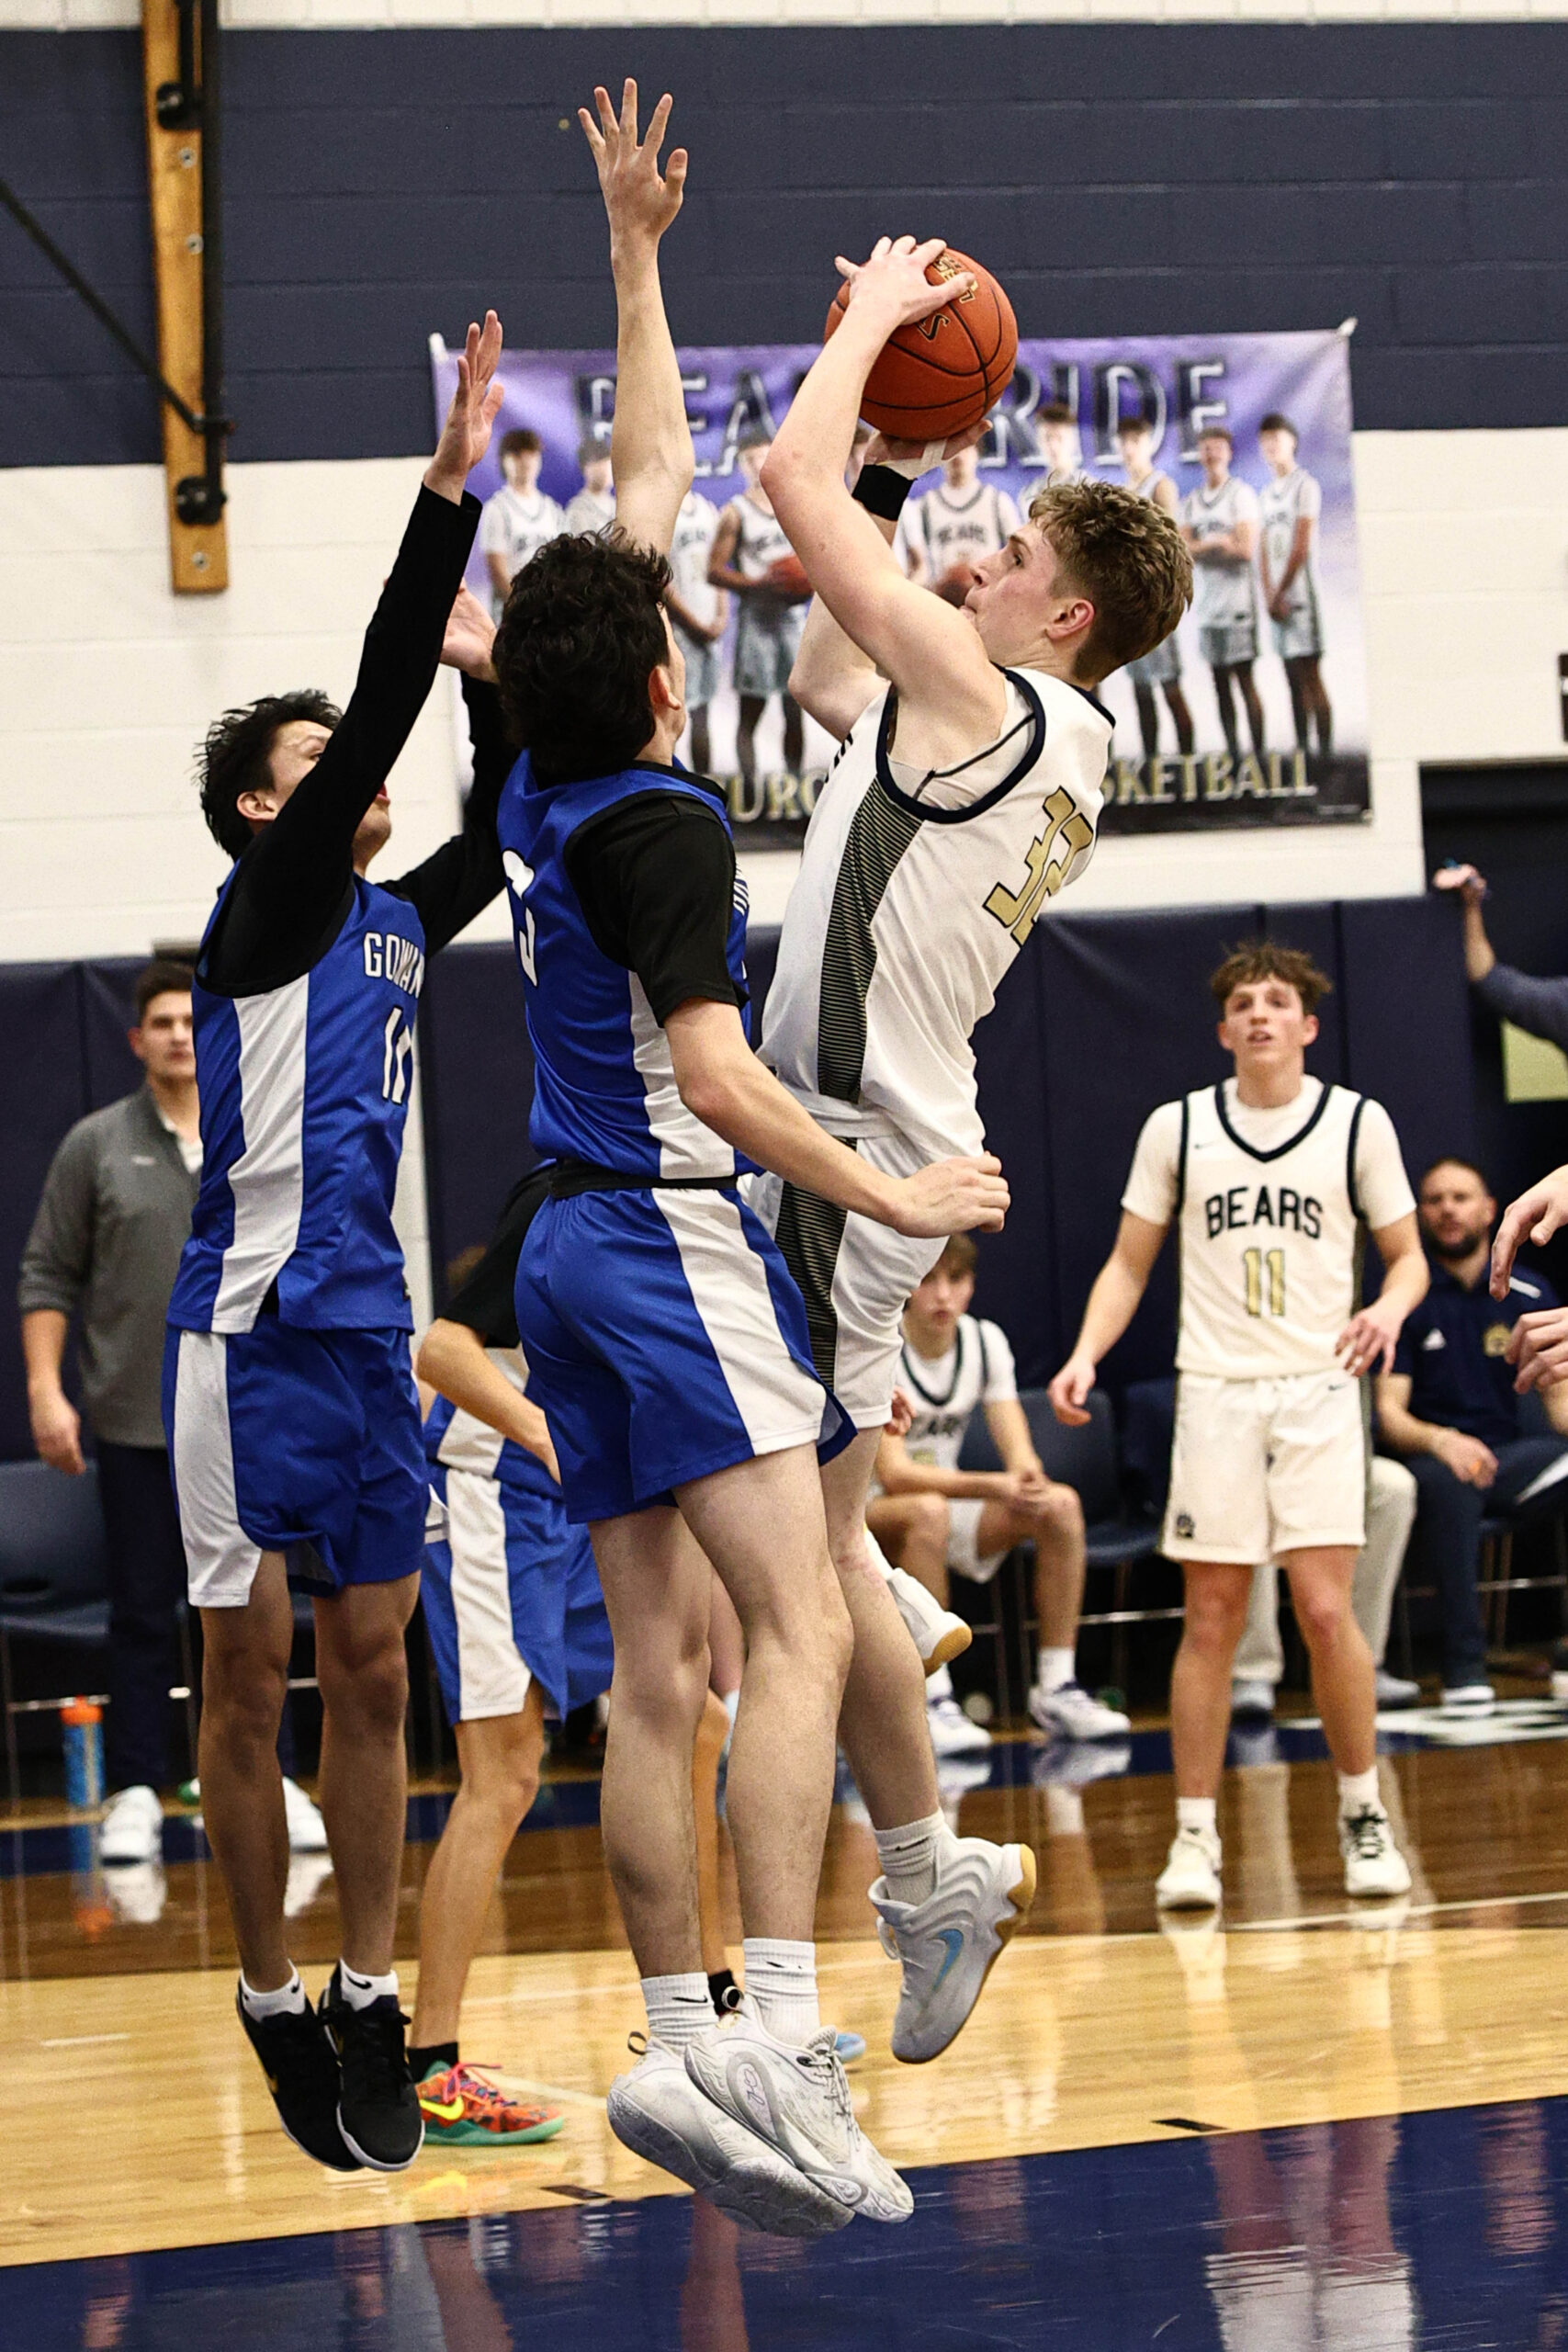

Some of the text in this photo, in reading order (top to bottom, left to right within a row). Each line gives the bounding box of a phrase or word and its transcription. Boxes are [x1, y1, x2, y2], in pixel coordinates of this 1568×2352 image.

[977, 357, 1229, 467] RIDE
[1205, 1186, 1323, 1239] BEARS
[1244, 1247, 1285, 1317] 11
